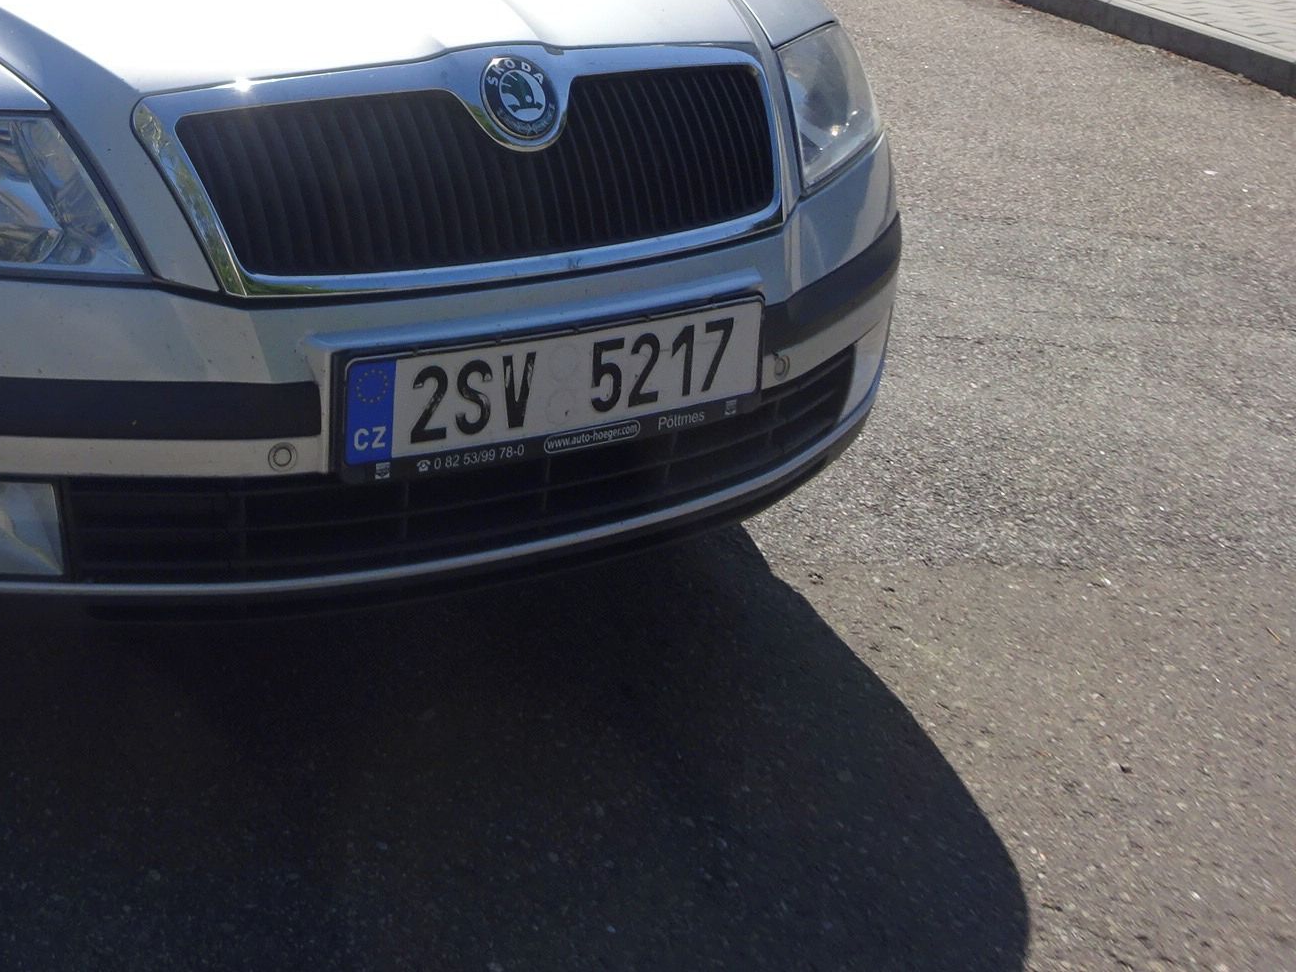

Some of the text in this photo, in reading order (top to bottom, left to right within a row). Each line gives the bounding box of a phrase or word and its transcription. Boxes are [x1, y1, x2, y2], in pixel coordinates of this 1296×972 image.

[409, 317, 735, 445] 2SV 5217
[353, 426, 386, 451] CZ
[546, 423, 638, 450] www.auto-hoeger.com
